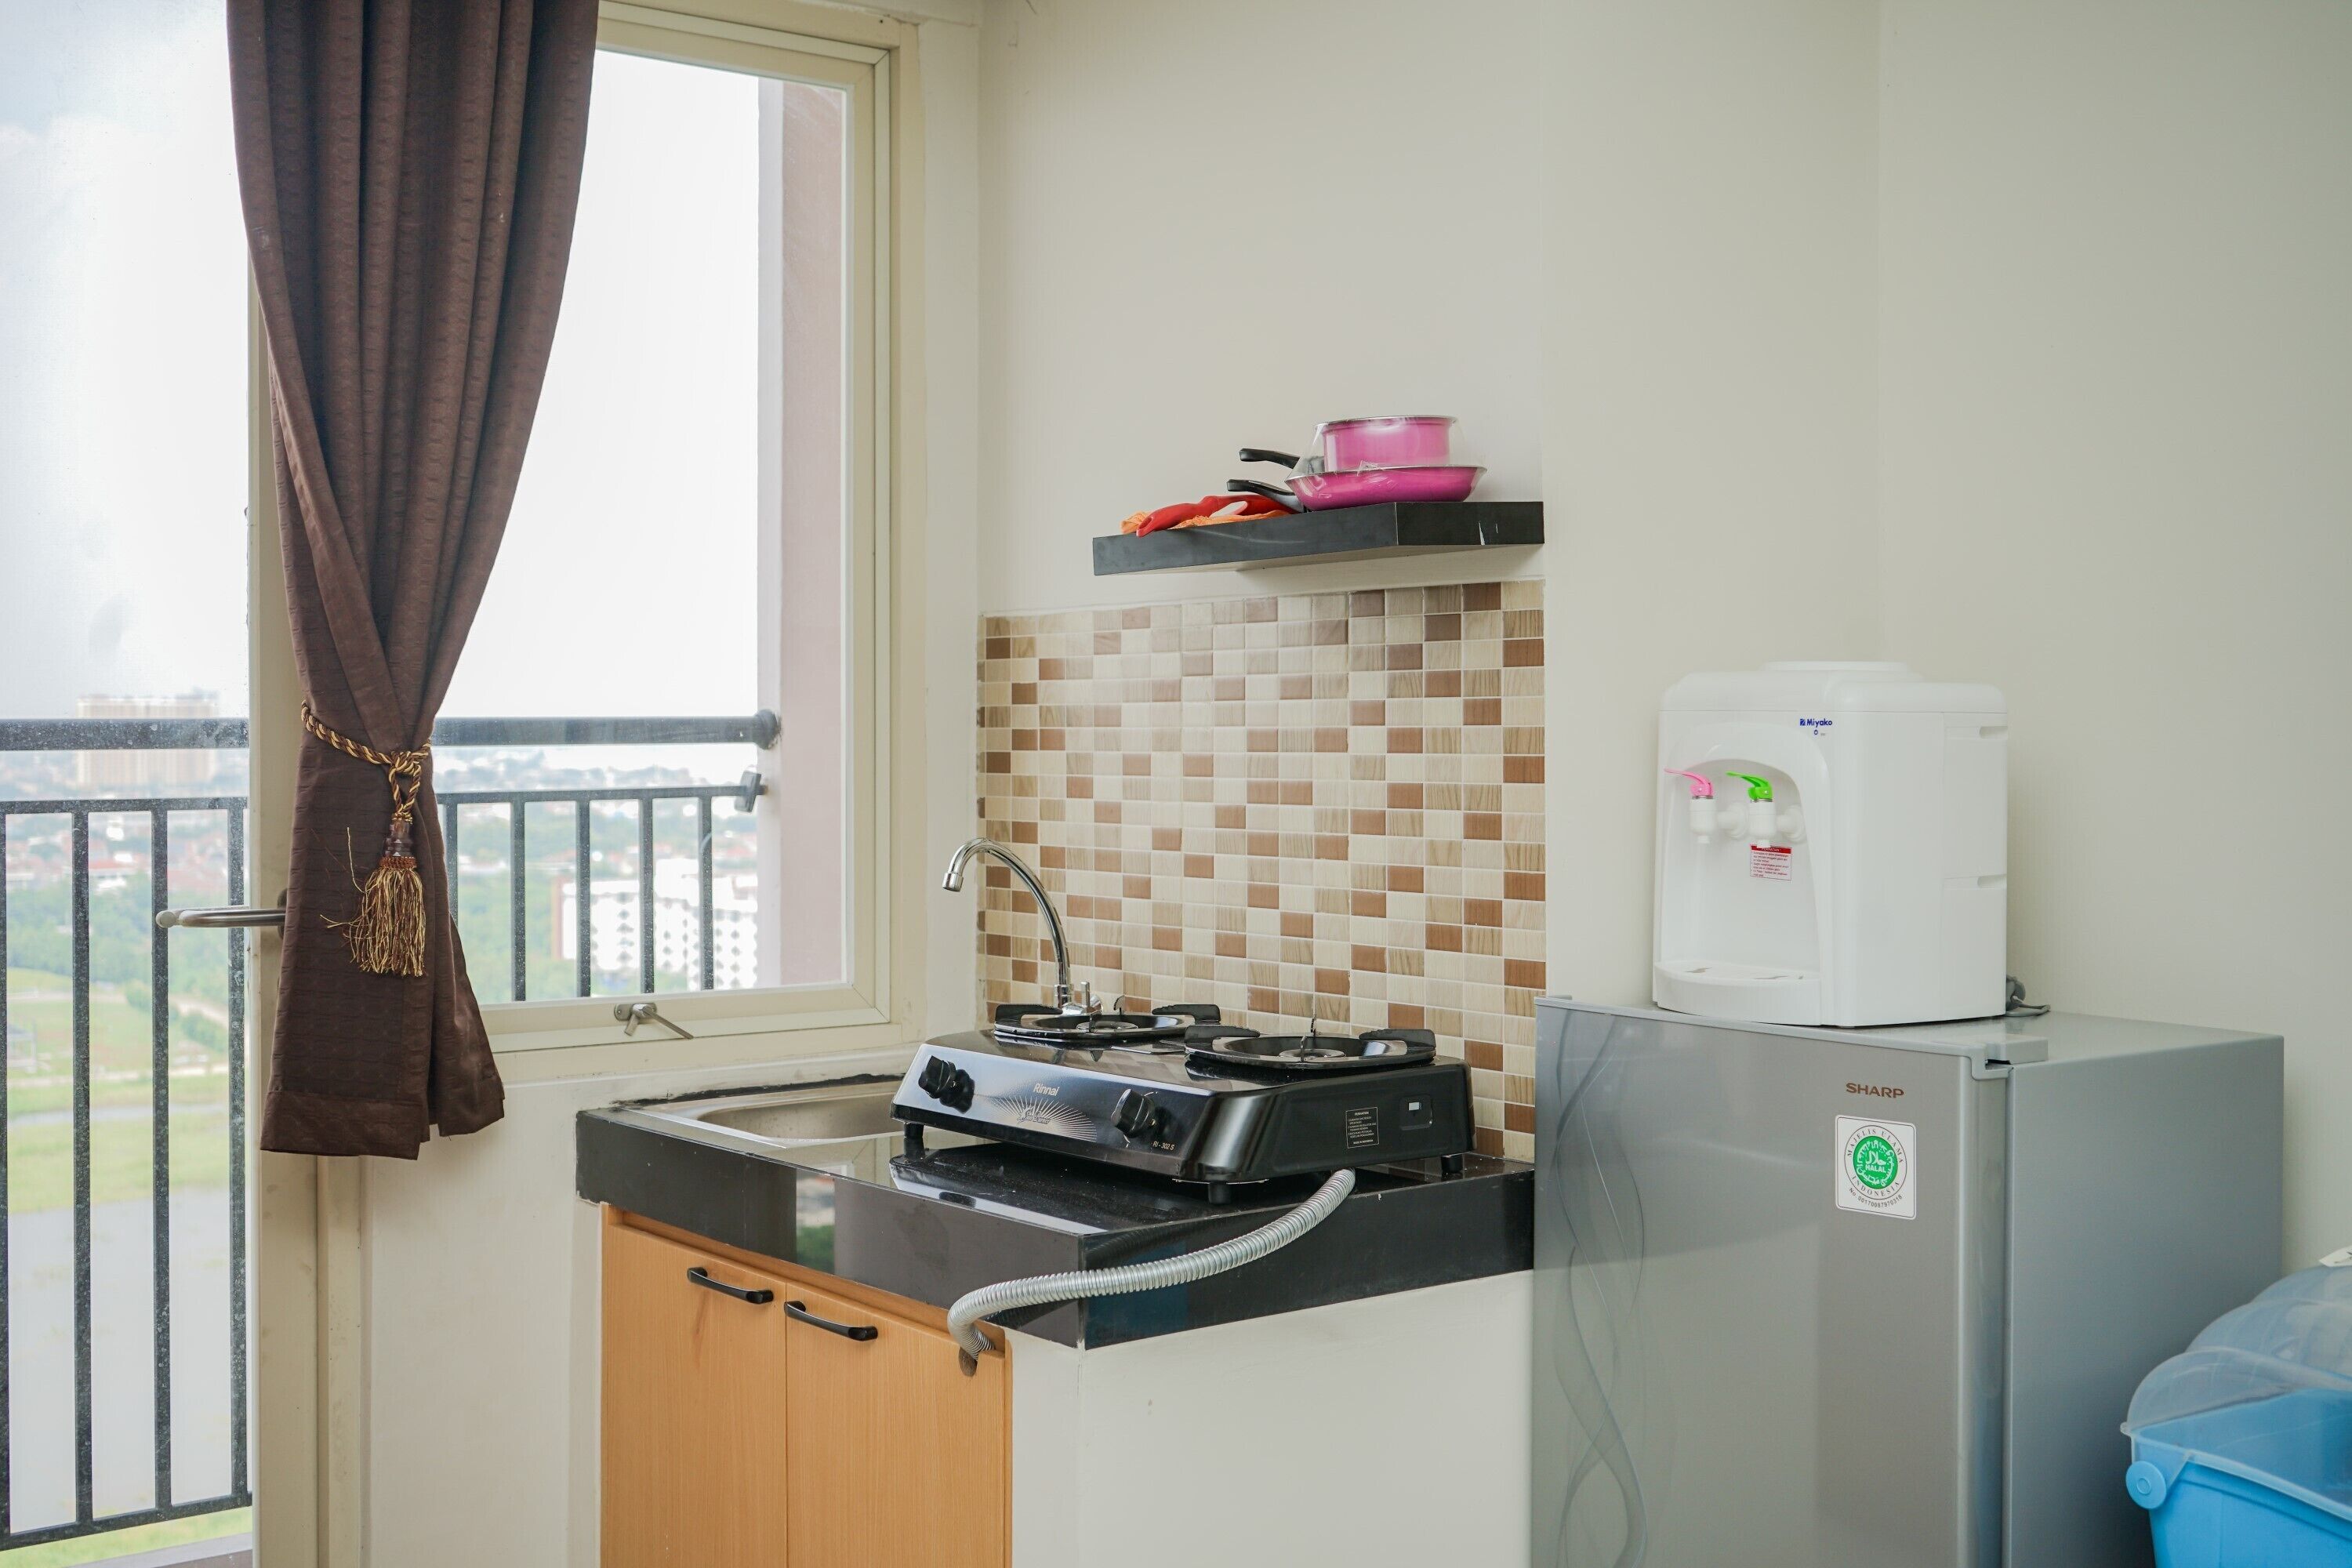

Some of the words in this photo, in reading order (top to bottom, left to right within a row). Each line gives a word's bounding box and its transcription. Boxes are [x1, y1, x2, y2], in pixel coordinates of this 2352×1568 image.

[1806, 718, 1833, 728] Miyako
[1033, 1083, 1059, 1096] Rinnai
[1846, 1083, 1904, 1098] SHARP
[1847, 1129, 1876, 1157] MAJELIS
[1882, 1131, 1904, 1163] ULAMA
[1865, 1163, 1887, 1174] HALAL
[1852, 1175, 1900, 1196] INDONESIA
